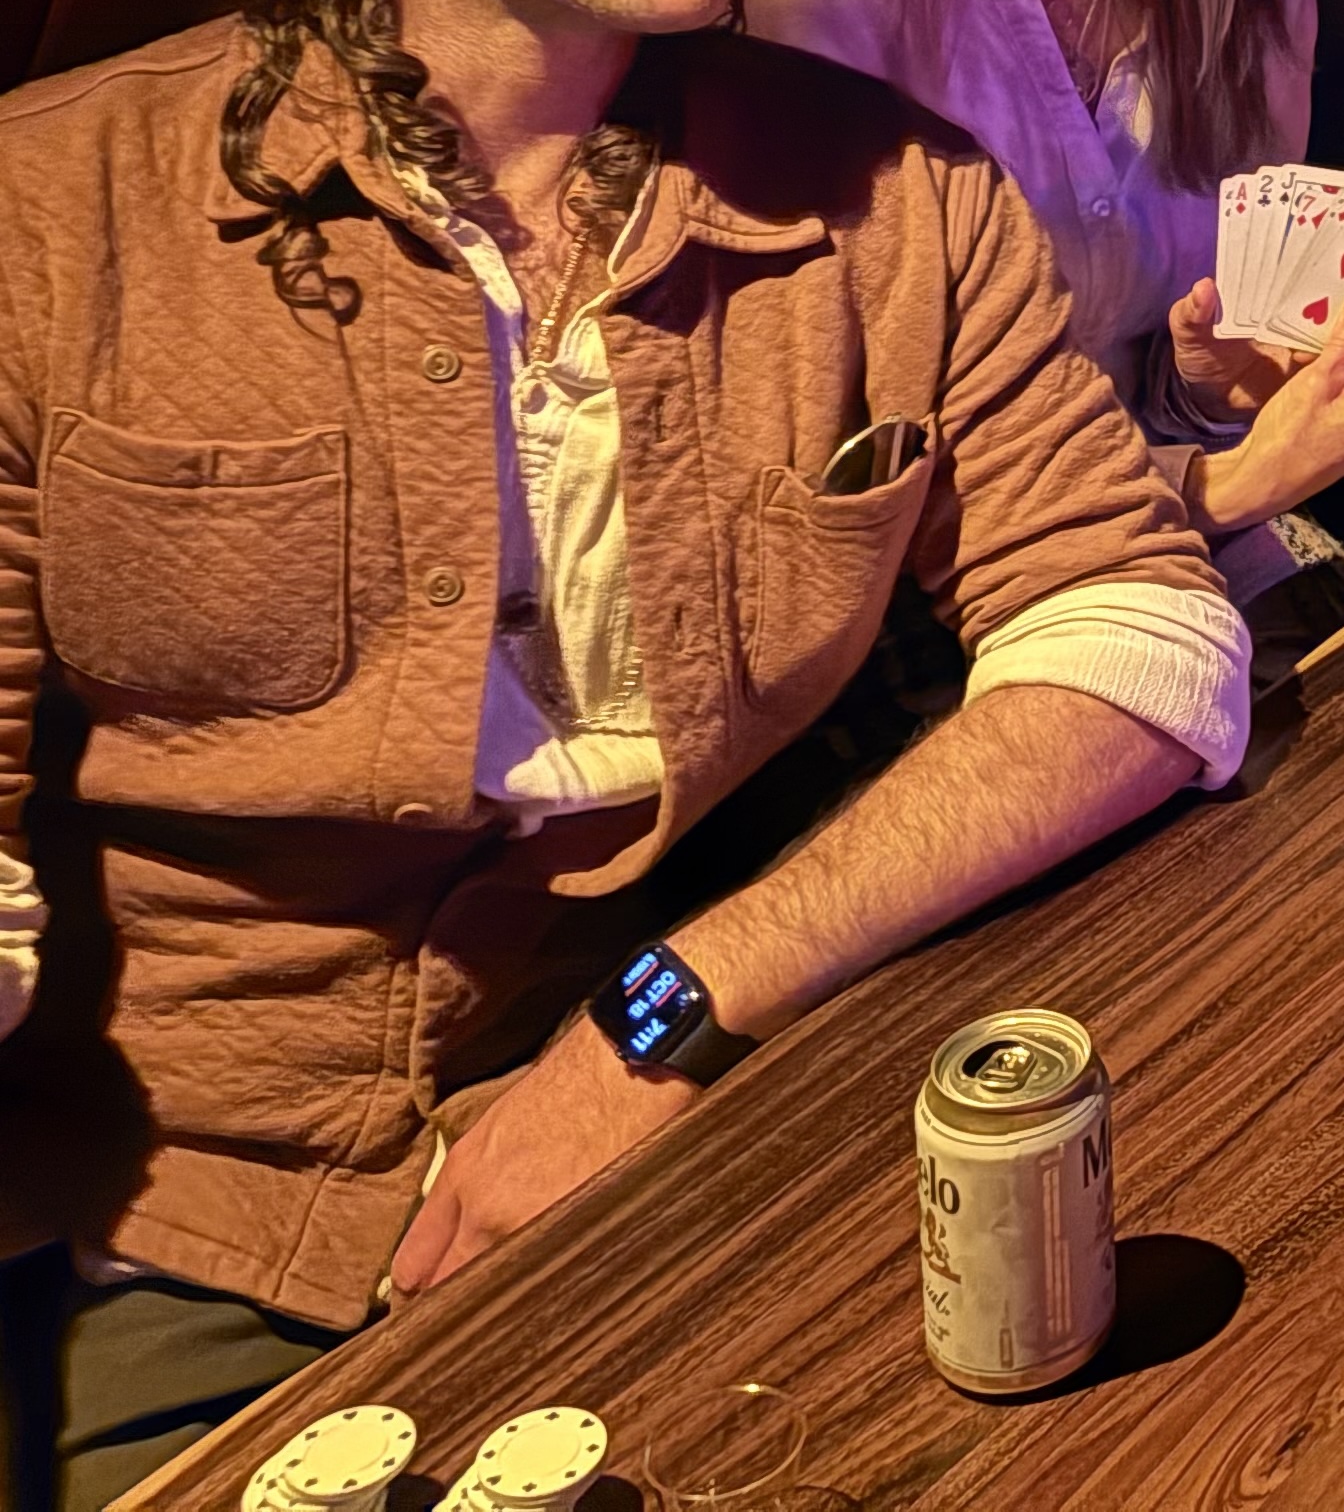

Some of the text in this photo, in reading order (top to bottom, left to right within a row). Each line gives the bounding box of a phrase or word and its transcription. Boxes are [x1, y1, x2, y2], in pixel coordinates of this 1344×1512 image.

[1260, 175, 1274, 193] 2
[1281, 172, 1297, 189] J
[1236, 182, 1247, 200] A
[1302, 195, 1316, 212] 7
[645, 971, 677, 1004] OCT
[630, 1018, 669, 1053] 7:11
[918, 1155, 960, 1215] elo
